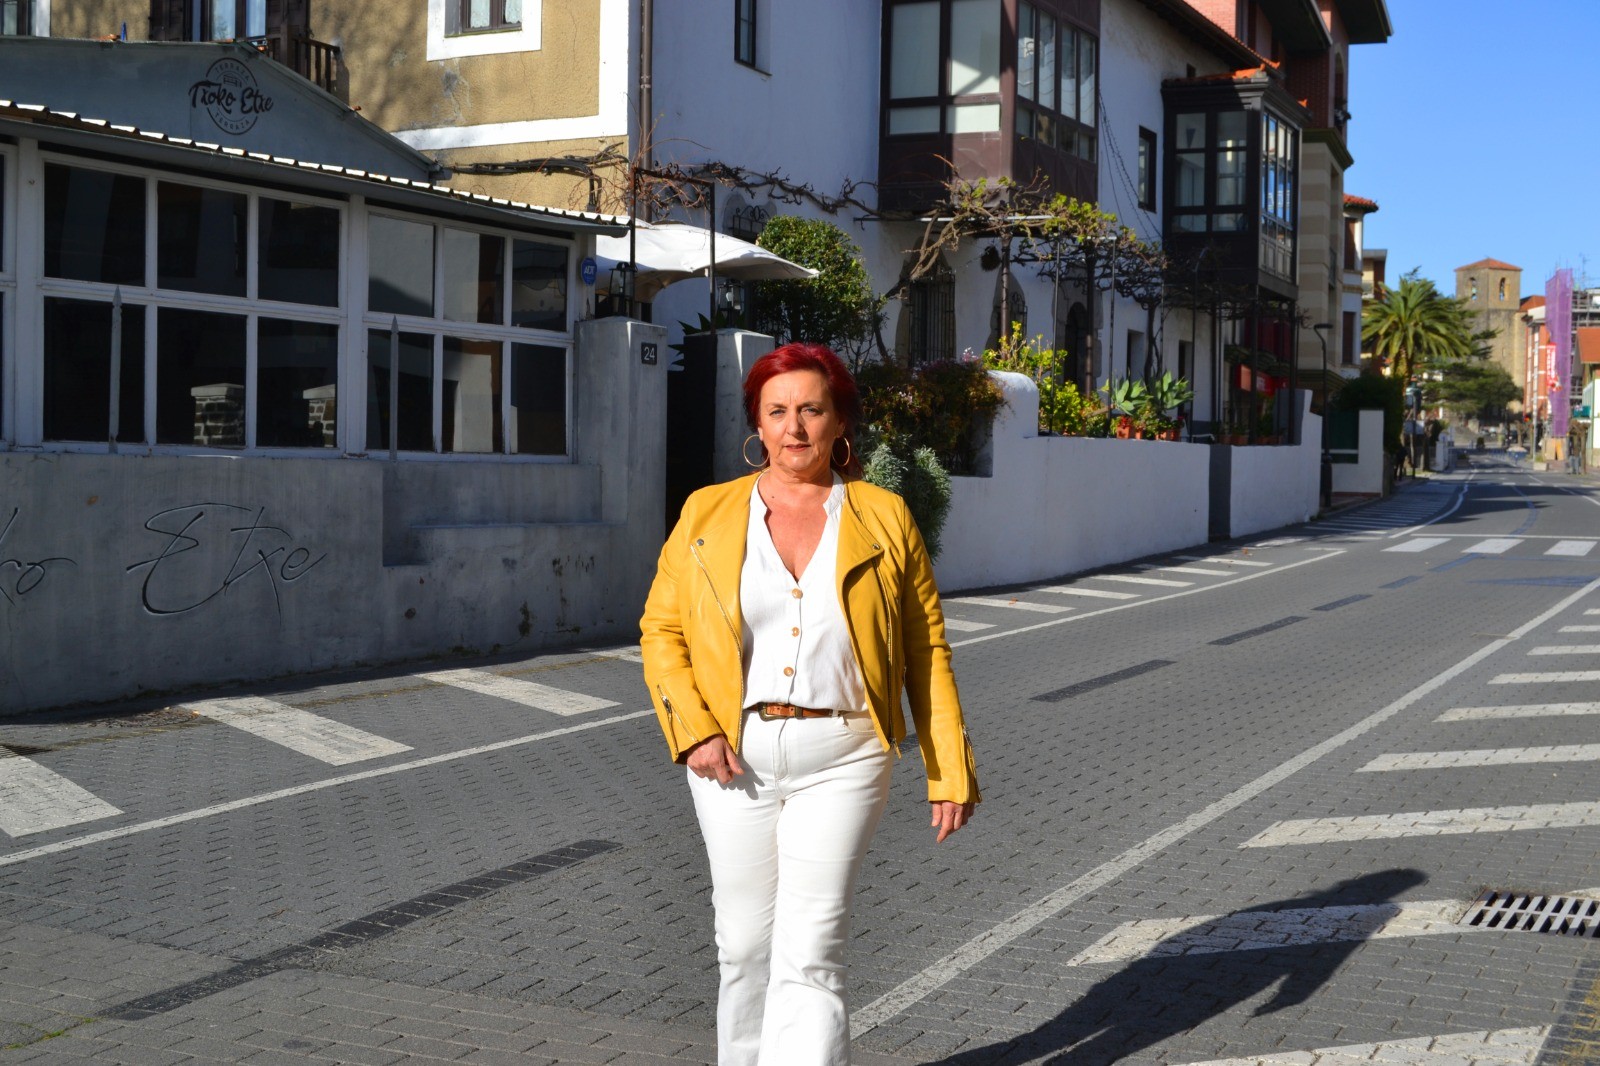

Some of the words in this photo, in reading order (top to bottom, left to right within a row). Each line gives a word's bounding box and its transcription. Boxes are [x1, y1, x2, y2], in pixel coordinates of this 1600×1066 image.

[214, 62, 250, 81] TERRAZA
[188, 80, 236, 114] Txoko
[241, 87, 274, 114] Etxe
[214, 112, 250, 131] TERRAZA
[643, 346, 655, 361] 24
[126, 503, 327, 626] Etxe
